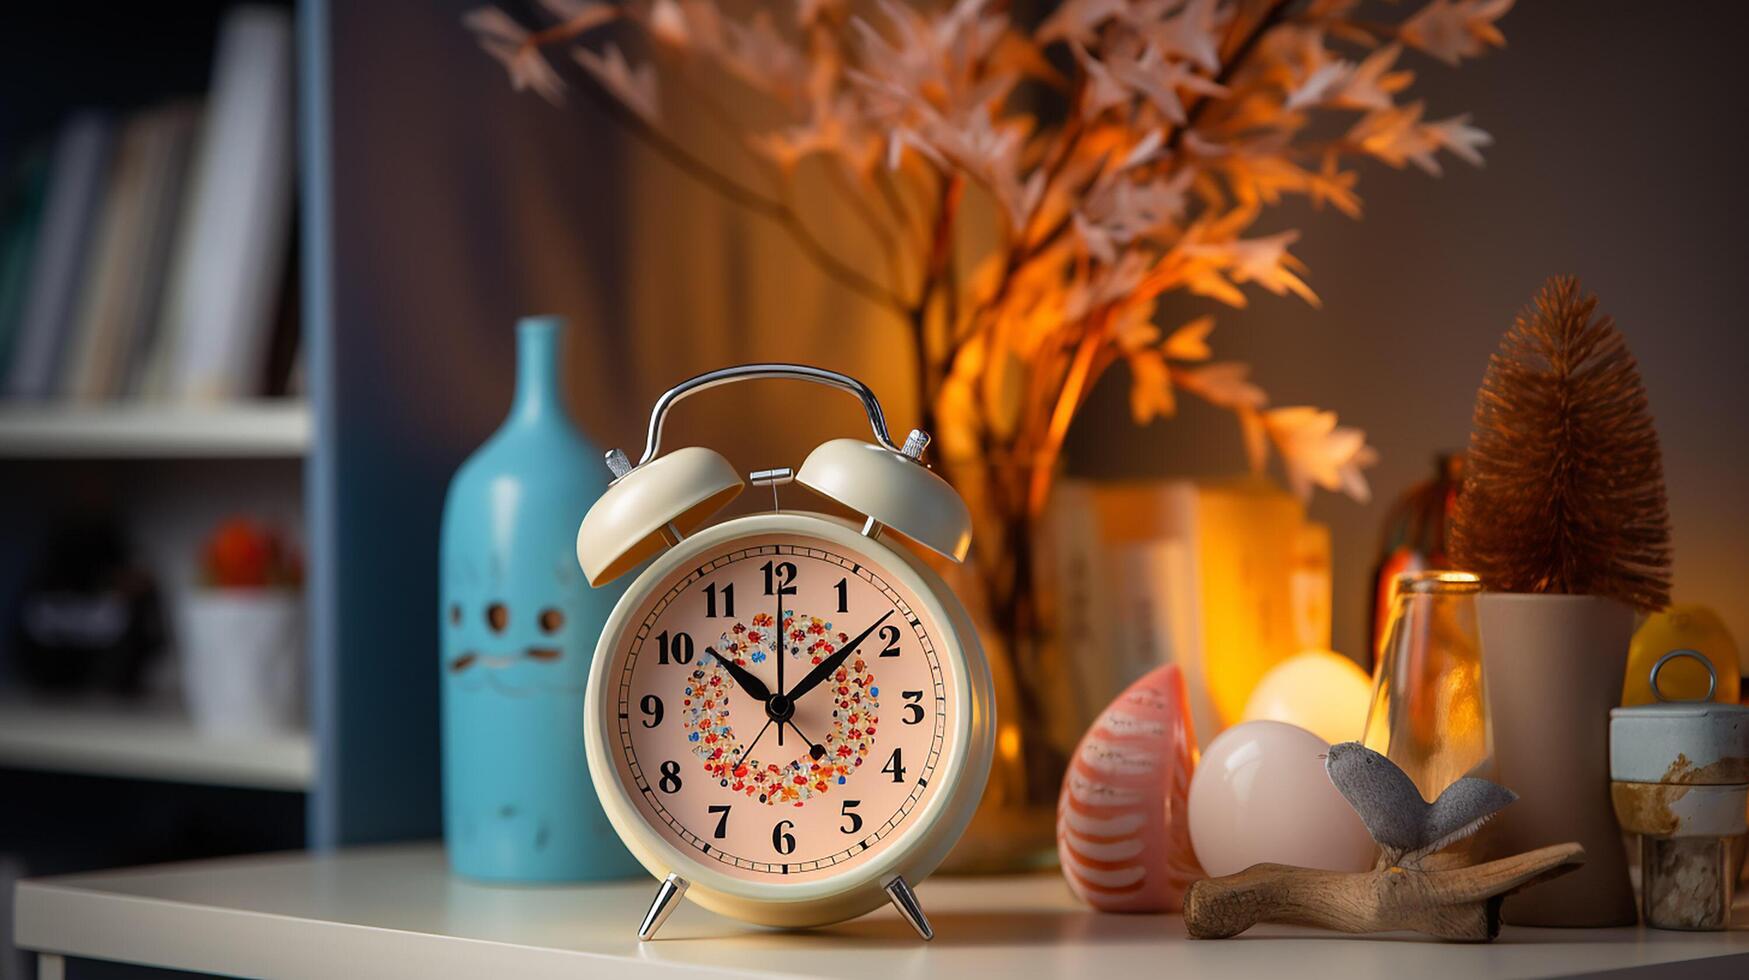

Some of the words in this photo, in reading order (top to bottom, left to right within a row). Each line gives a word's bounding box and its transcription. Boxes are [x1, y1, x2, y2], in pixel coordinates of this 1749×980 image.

[760, 560, 797, 595] 12
[702, 582, 735, 617] 11
[833, 578, 848, 612] 1
[655, 630, 694, 665] 10
[879, 626, 901, 657] 2
[640, 695, 664, 728] 9
[902, 691, 924, 724] 3
[659, 761, 682, 793] 8
[881, 748, 905, 782] 4
[708, 805, 731, 838] 7
[840, 801, 863, 834] 5
[772, 820, 796, 854] 6
